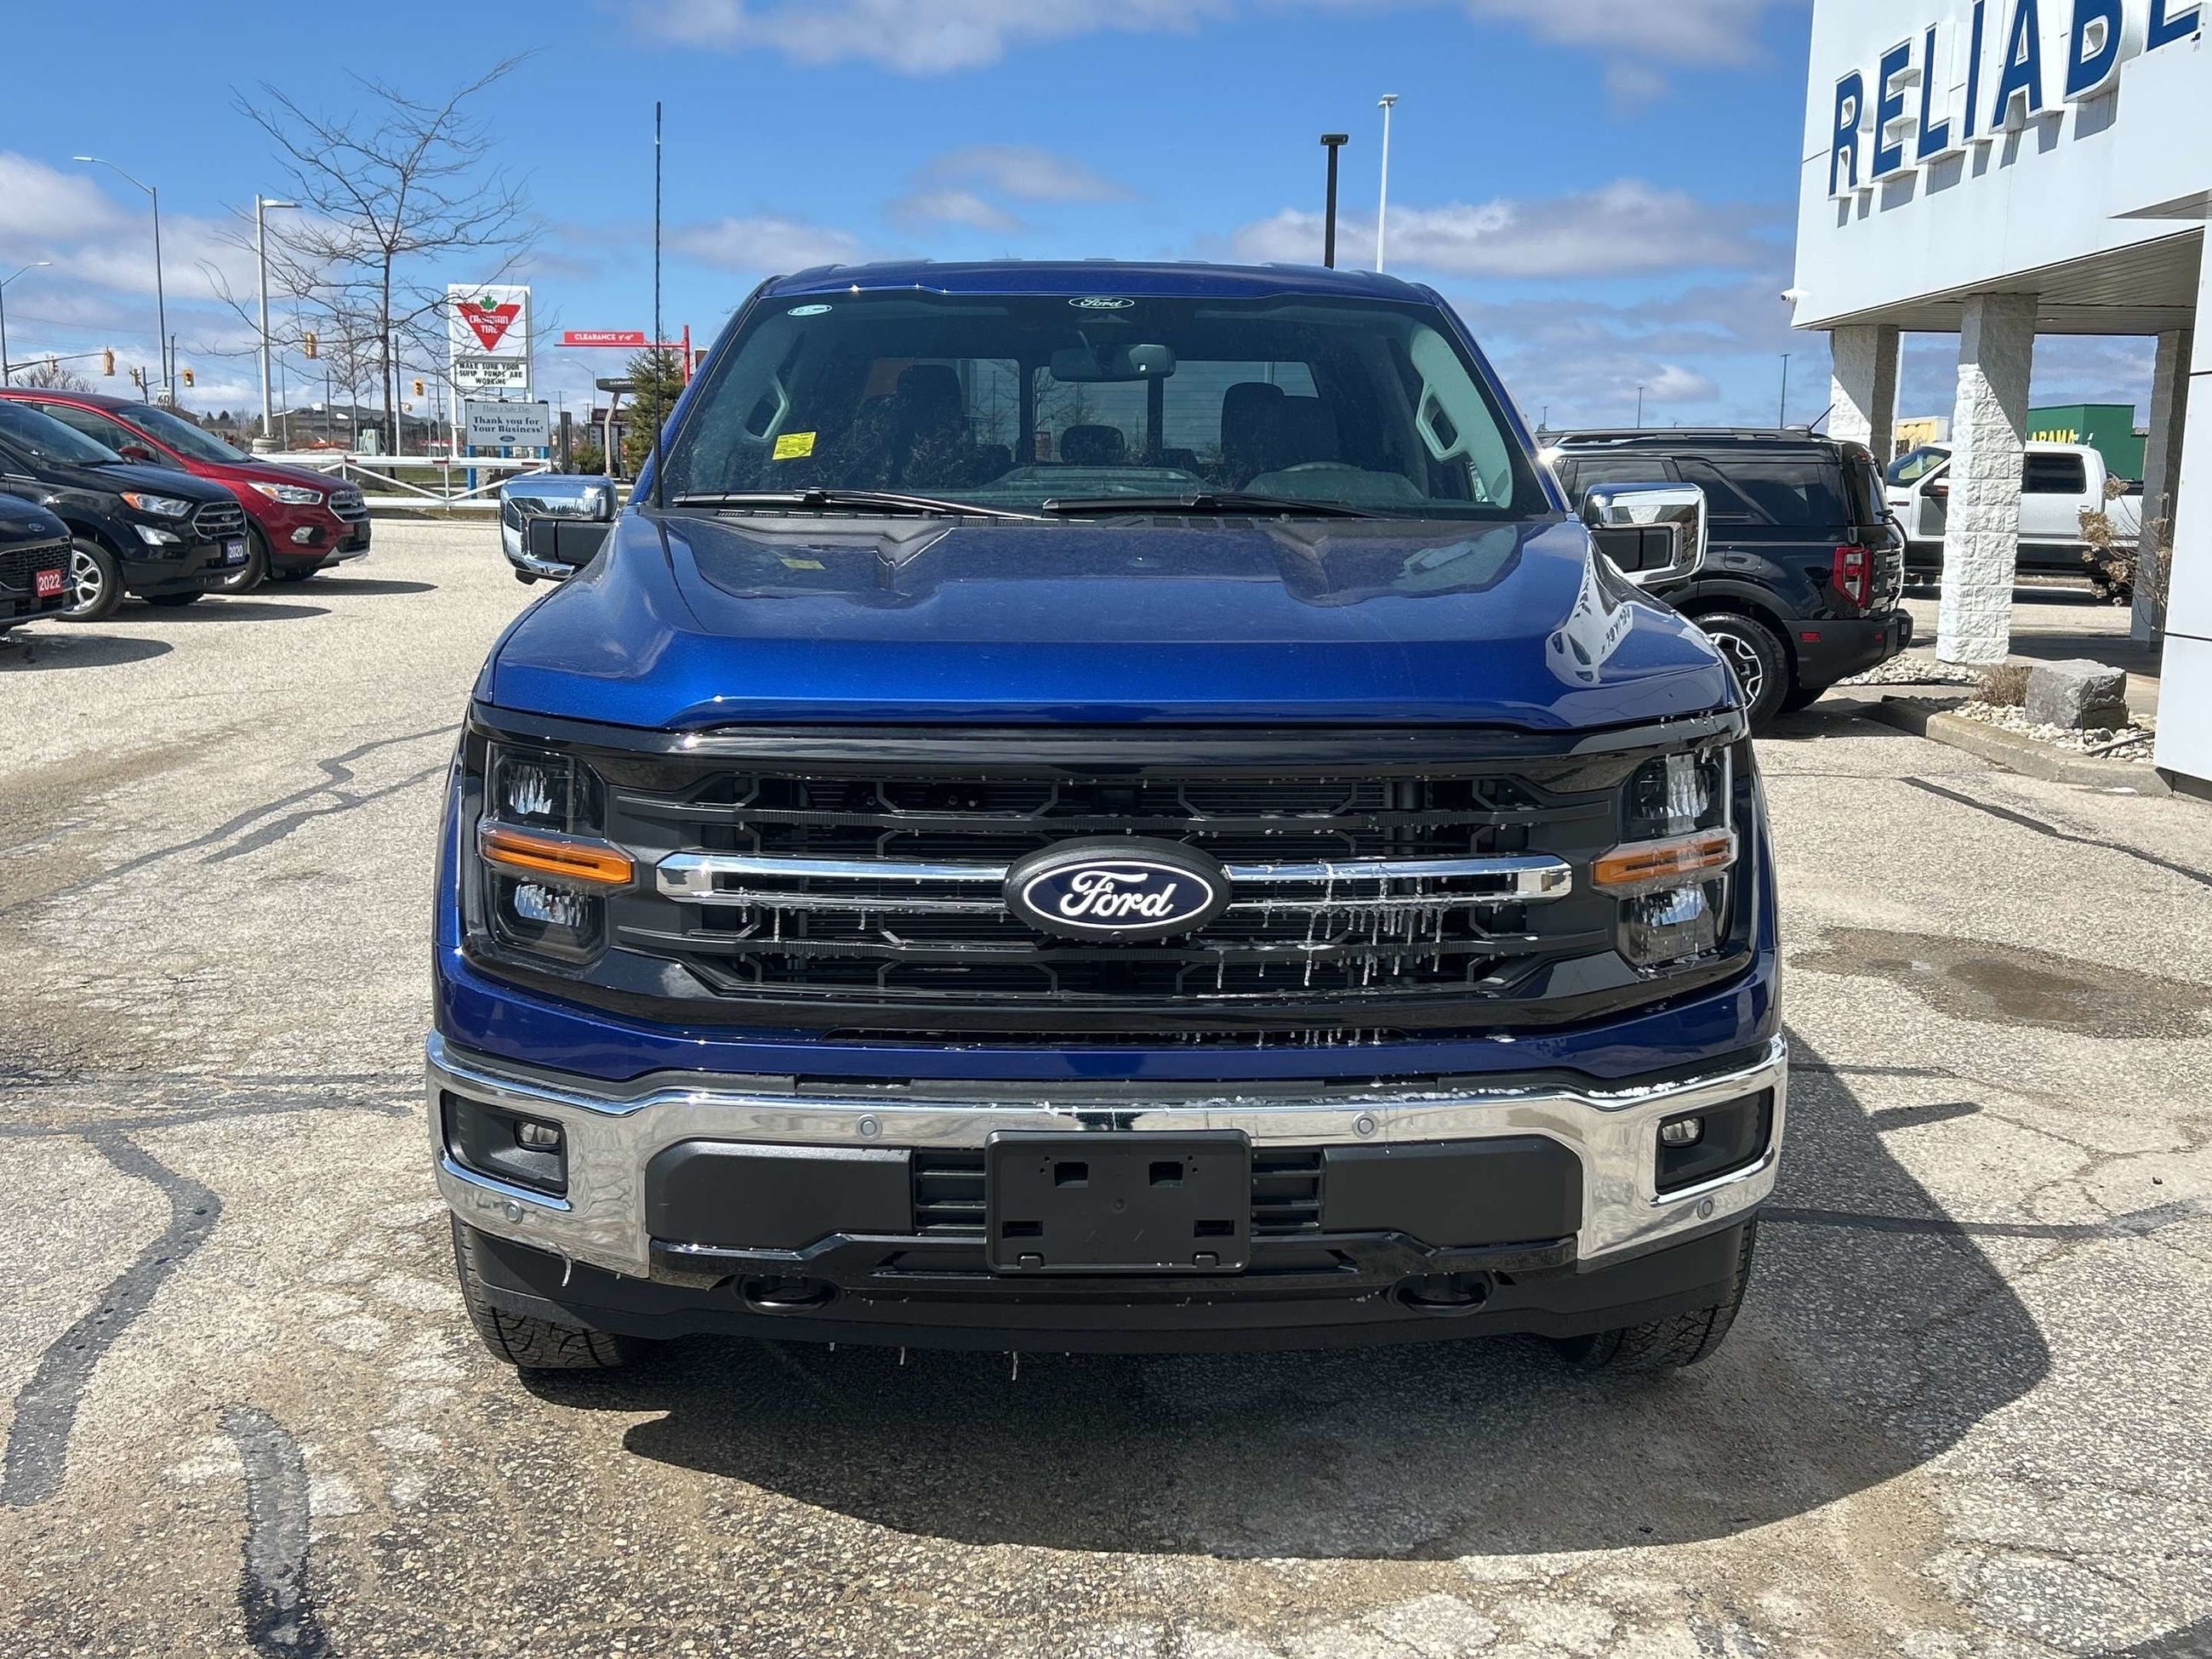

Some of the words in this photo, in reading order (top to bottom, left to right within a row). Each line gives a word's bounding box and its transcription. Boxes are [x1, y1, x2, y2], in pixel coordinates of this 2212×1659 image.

[1828, 0, 2203, 200] RELIAB
[1080, 298, 1122, 306] Ford
[474, 416, 503, 425] Thank
[505, 418, 522, 426] you
[525, 417, 539, 425] for
[229, 544, 243, 558] 2020
[38, 574, 60, 591] 2022
[1059, 870, 1177, 916] Ford
